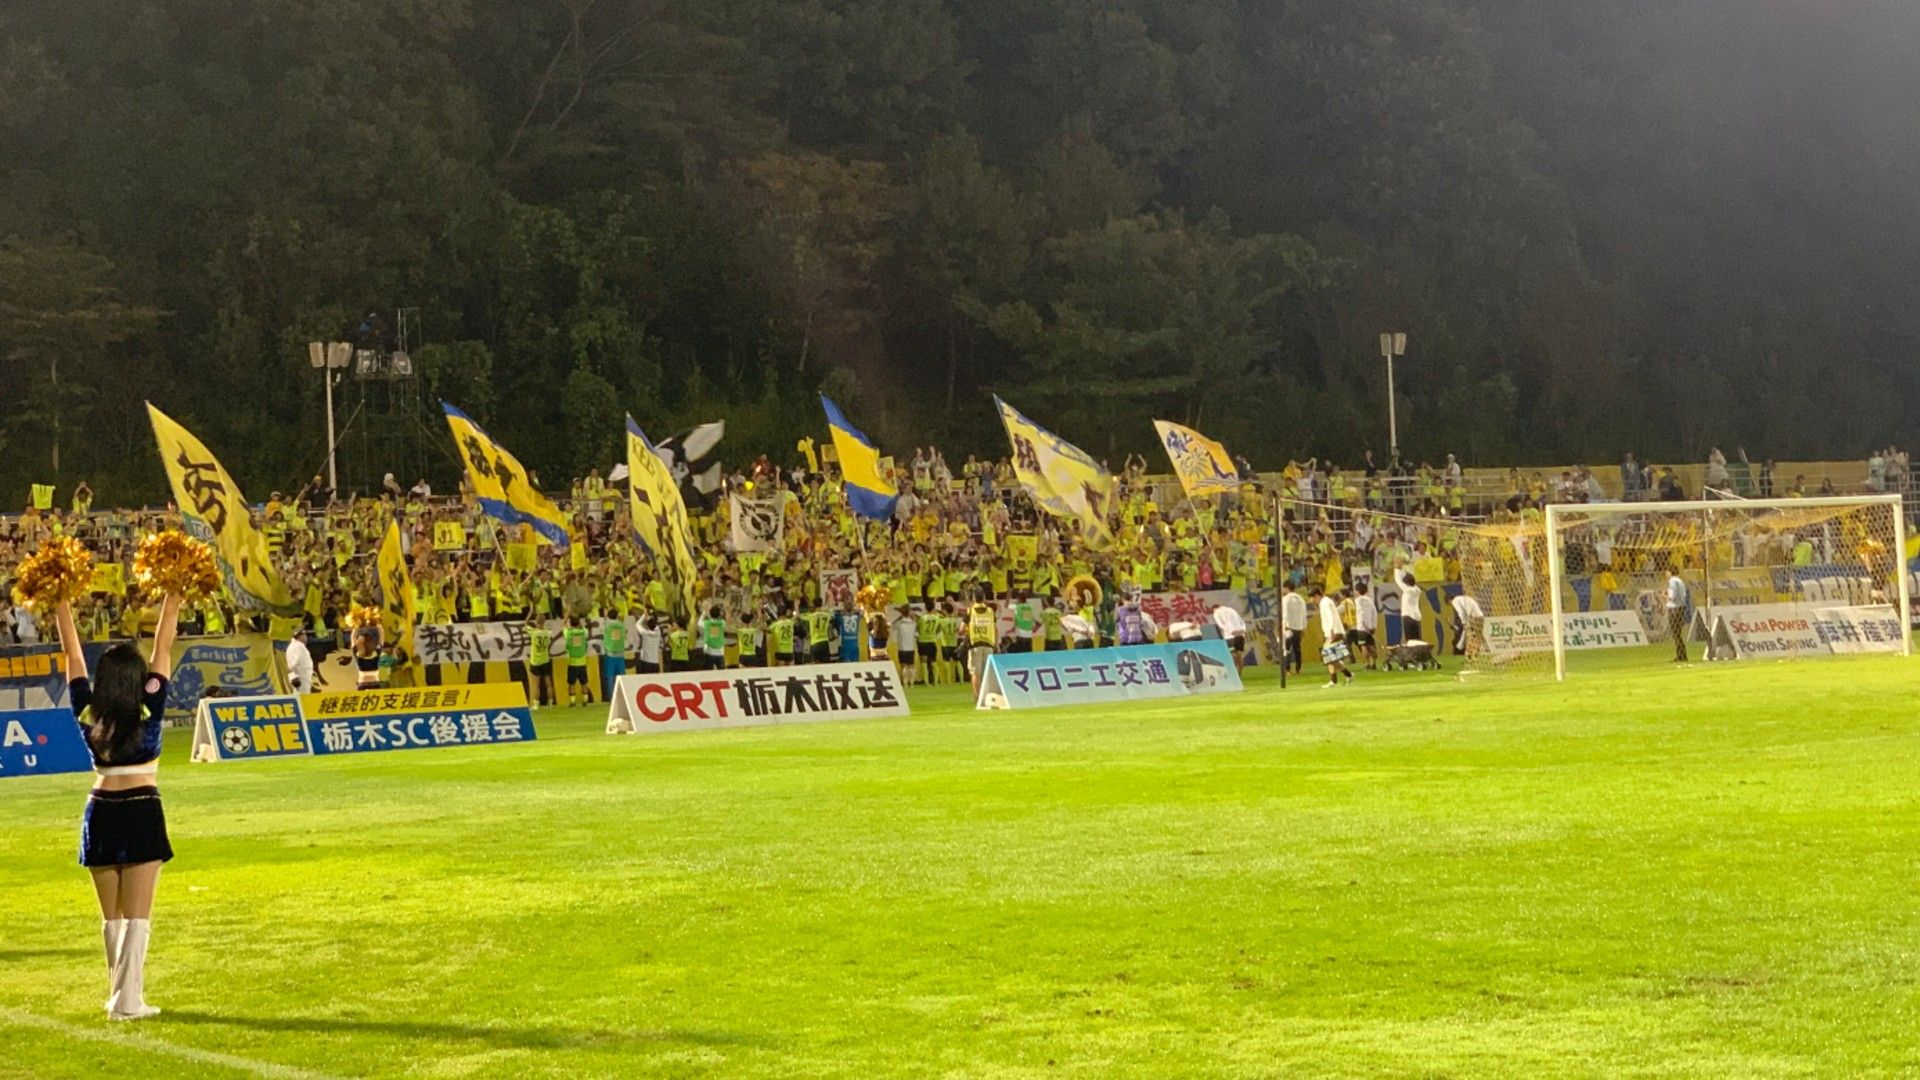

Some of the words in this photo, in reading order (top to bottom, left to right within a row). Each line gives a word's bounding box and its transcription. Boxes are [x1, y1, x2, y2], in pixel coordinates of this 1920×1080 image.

[1006, 658, 1171, 693] マロニエ交通
[215, 707, 249, 722] WE
[253, 703, 297, 721] ARE
[321, 712, 521, 750] 栃木SC後援会
